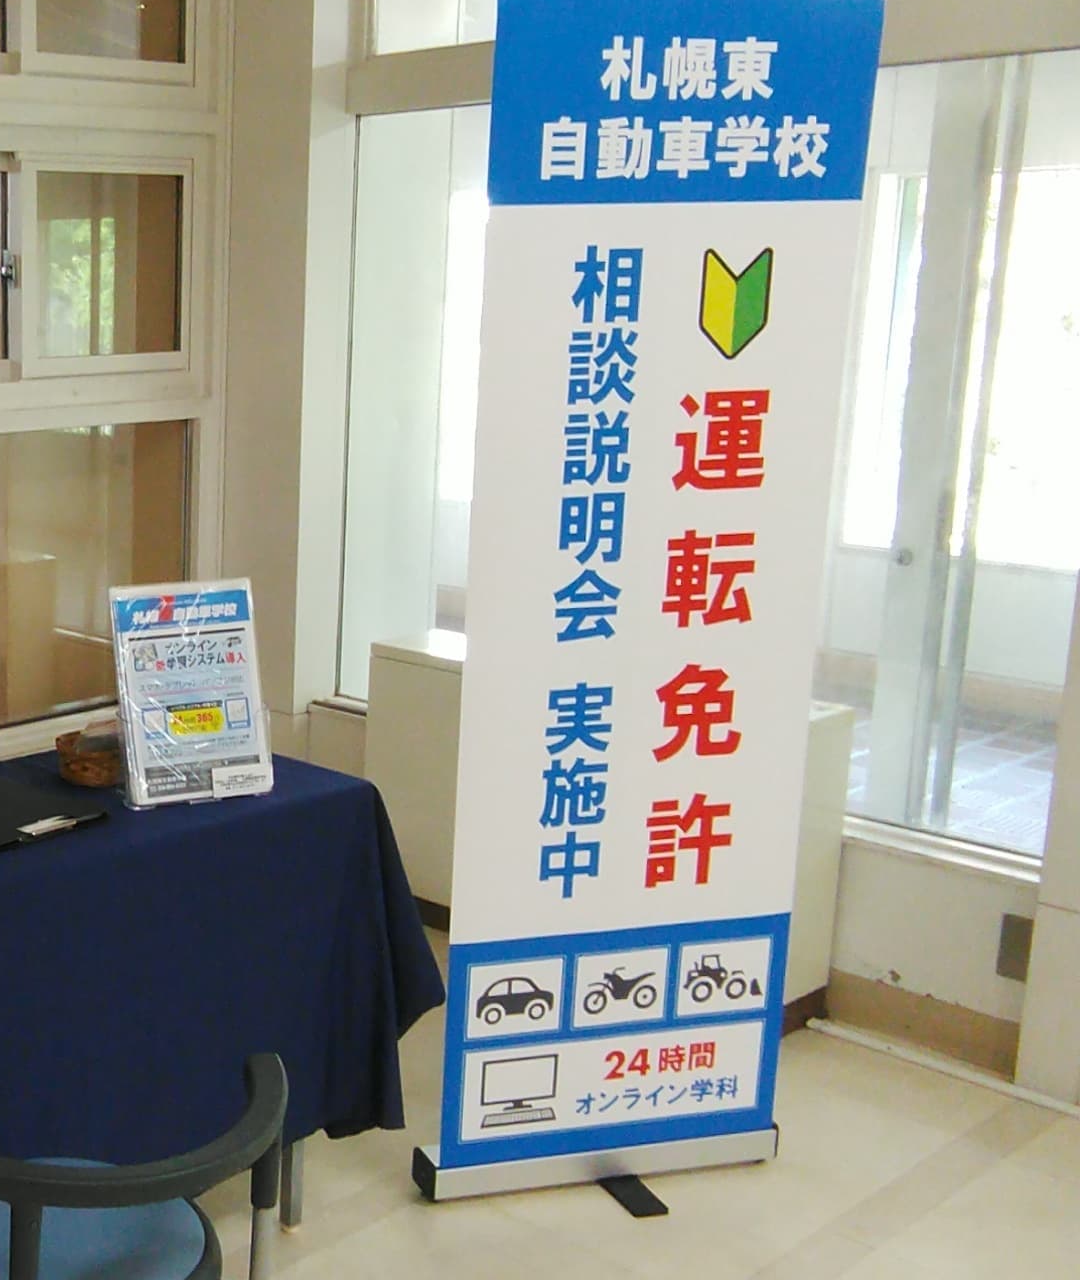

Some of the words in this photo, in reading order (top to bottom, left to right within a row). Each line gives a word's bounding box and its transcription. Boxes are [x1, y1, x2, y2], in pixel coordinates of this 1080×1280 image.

[601, 36, 778, 101] 札幌東
[540, 115, 830, 181] 自動車学校
[555, 246, 643, 641] 相談説明会
[645, 390, 771, 888] 運転免許
[540, 683, 613, 898] 実施中
[604, 1041, 717, 1081] 24時間
[576, 1076, 739, 1115] オンライン学科
